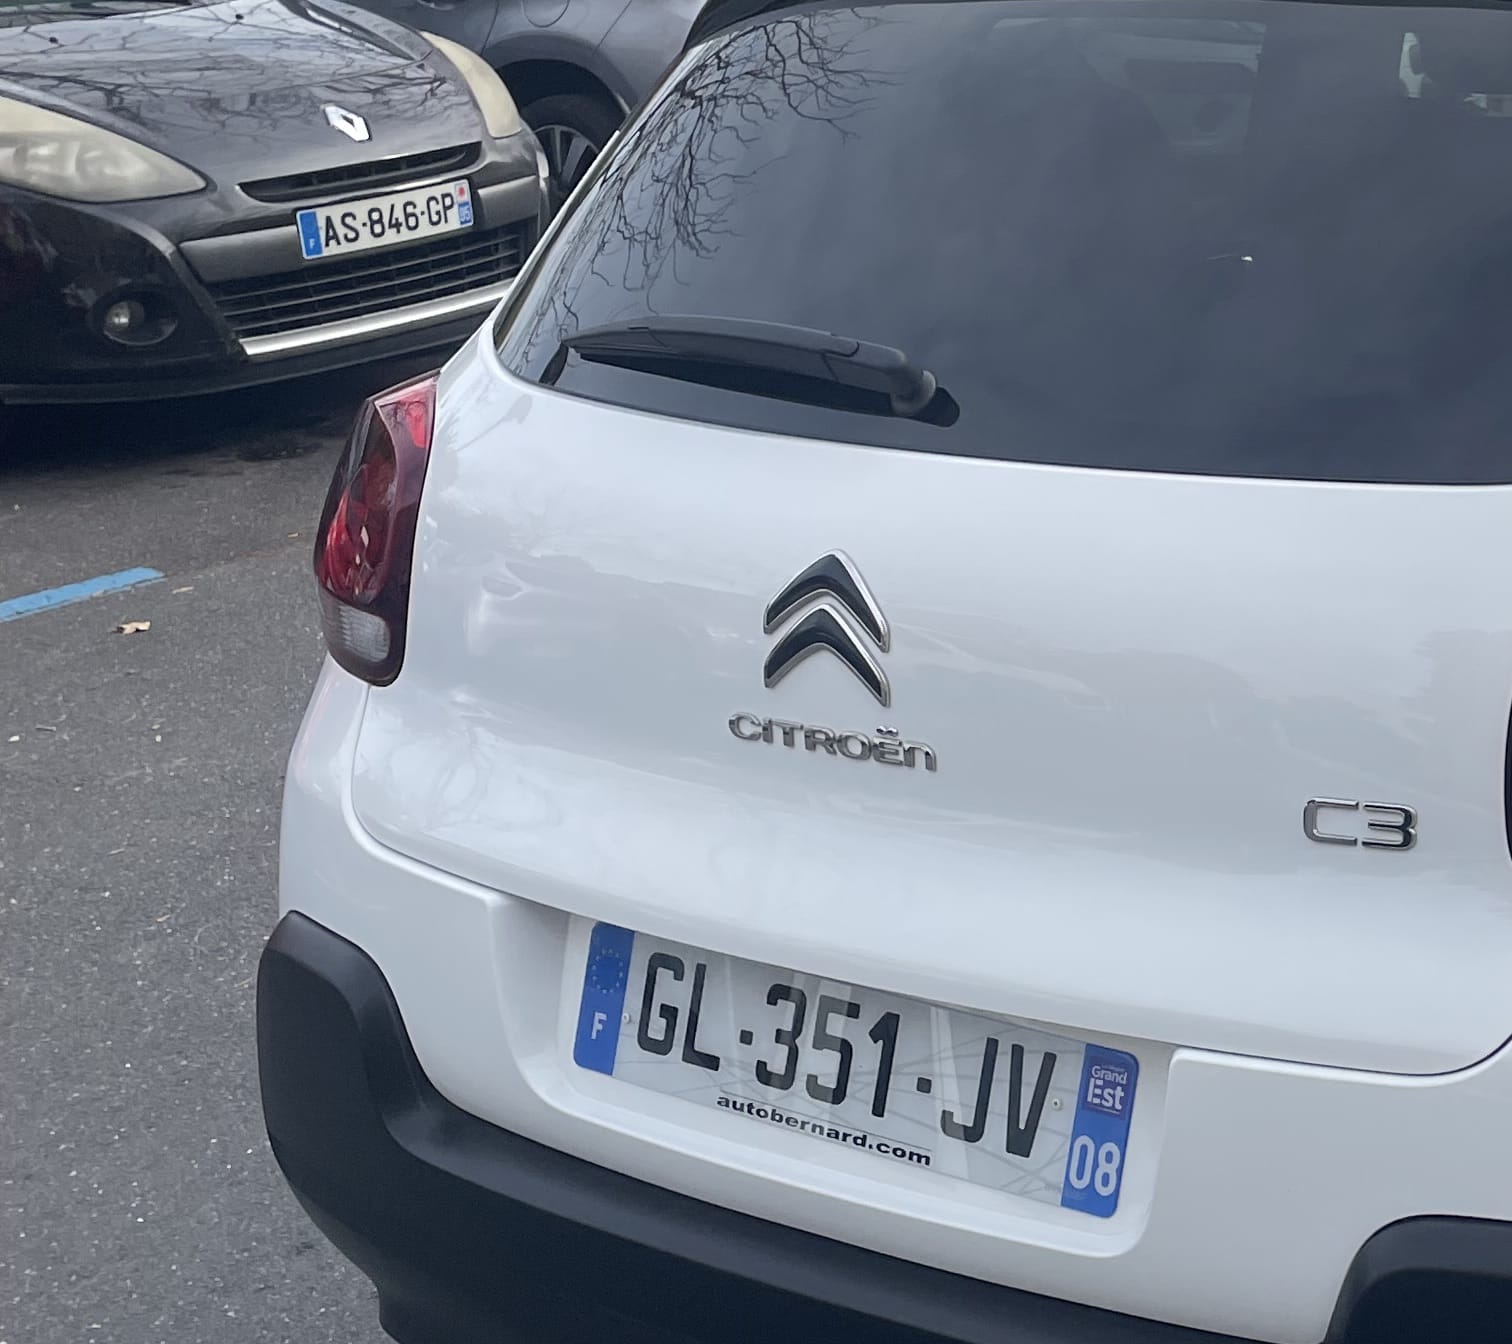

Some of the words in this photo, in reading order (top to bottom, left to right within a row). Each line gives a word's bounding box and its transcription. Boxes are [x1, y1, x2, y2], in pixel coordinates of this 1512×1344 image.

[325, 193, 454, 247] AS-846-GP
[728, 711, 937, 772] CITROËN
[1302, 795, 1418, 851] C3
[591, 1011, 607, 1041] F
[636, 952, 1057, 1159] GL-351-JV
[1091, 1065, 1128, 1085] Grand
[1087, 1077, 1125, 1111] Est
[716, 1094, 932, 1167] autobernard.com
[1069, 1134, 1121, 1197] 08
